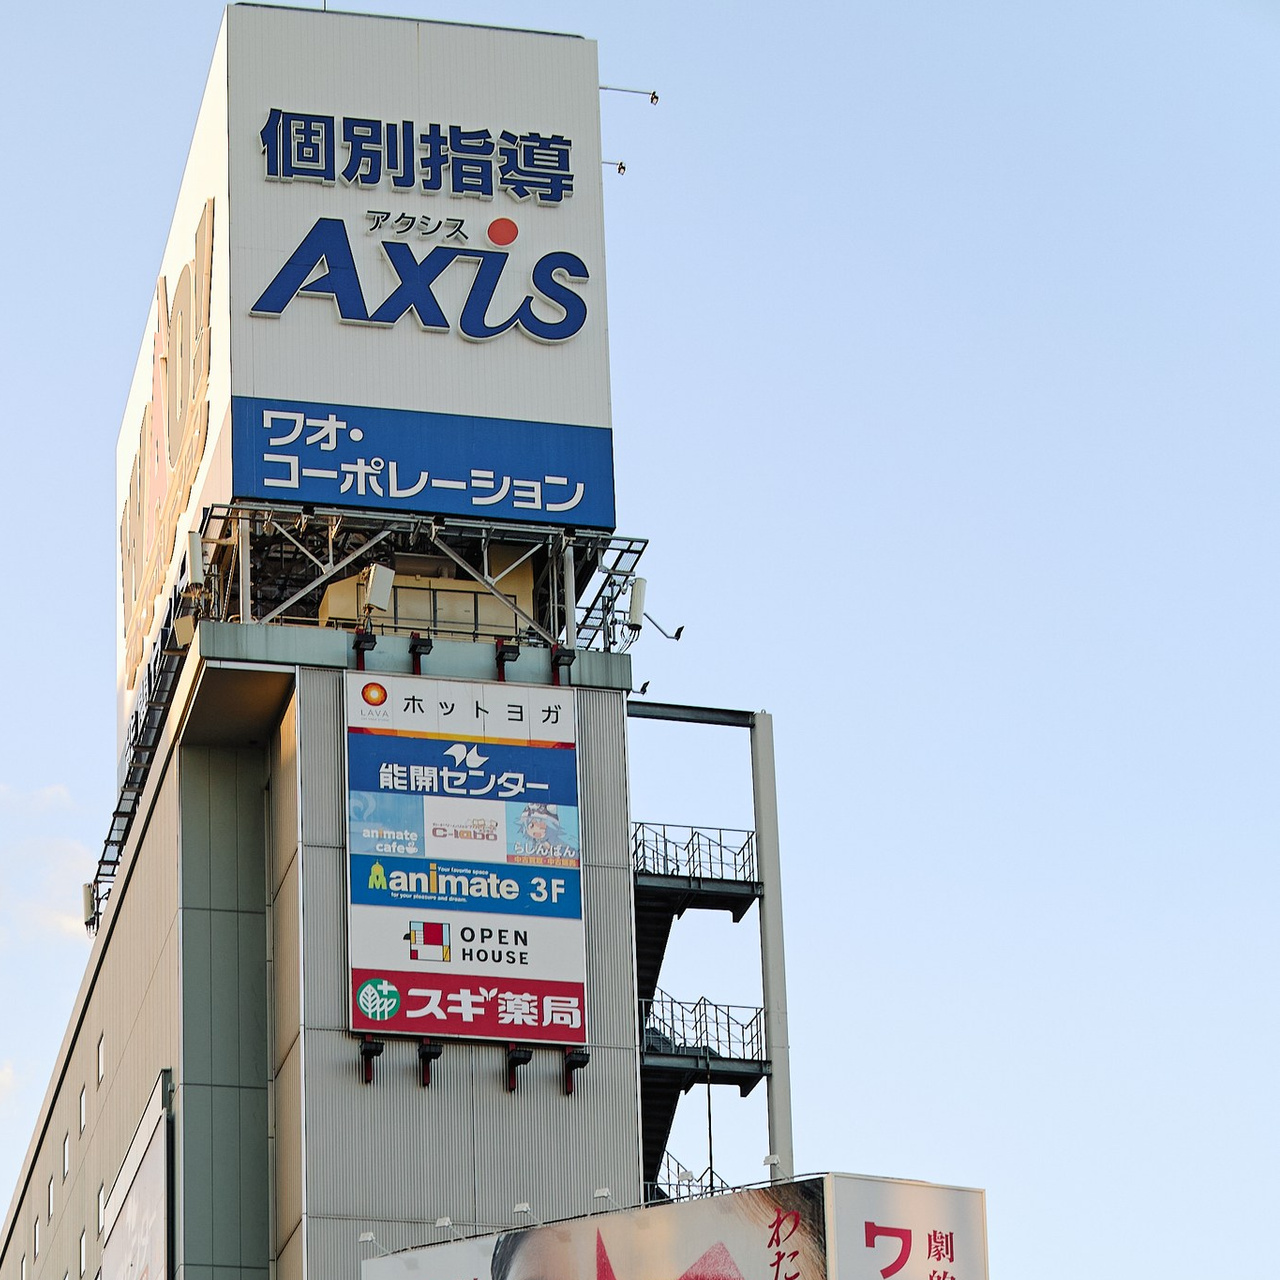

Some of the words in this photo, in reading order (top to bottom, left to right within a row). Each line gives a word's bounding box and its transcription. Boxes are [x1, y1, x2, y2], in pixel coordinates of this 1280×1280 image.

[260, 108, 575, 206] 個別指導
[366, 209, 469, 243] アクシス
[261, 452, 585, 513] コーポレーション
[360, 708, 389, 717] LAVA
[403, 695, 562, 724] ホットヨガ
[378, 761, 550, 798] 能開センター
[362, 826, 419, 841] animate
[375, 841, 407, 854] cafe
[513, 842, 576, 858] らしんばん
[388, 862, 520, 900] animate
[530, 876, 566, 904] 3F
[460, 926, 529, 948] OPEN
[461, 947, 529, 966] HOUSE
[405, 986, 582, 1029] スギ薬局
